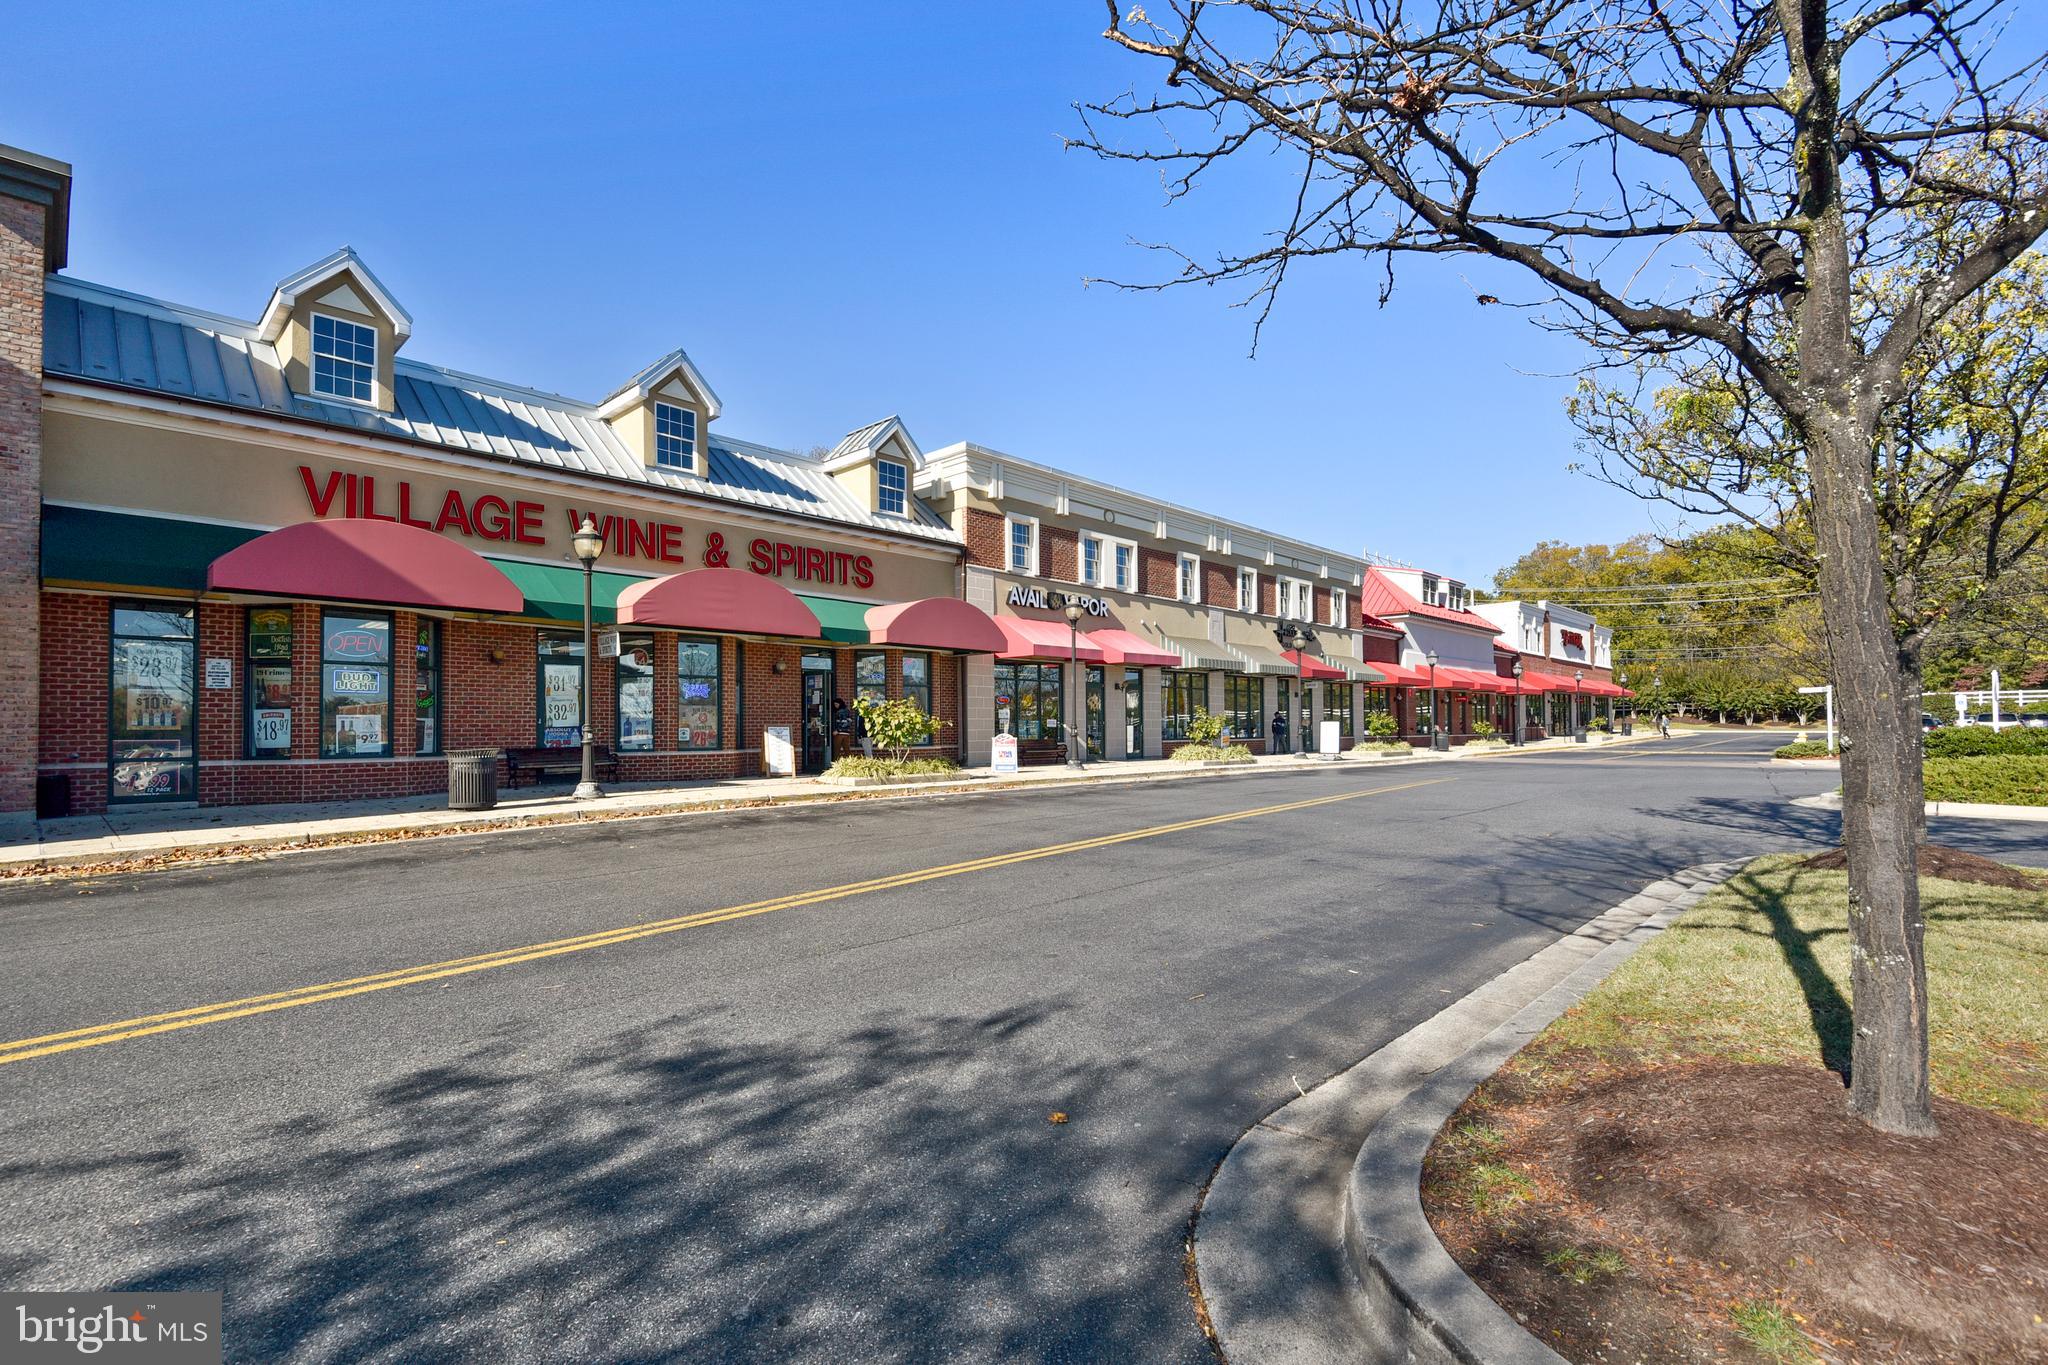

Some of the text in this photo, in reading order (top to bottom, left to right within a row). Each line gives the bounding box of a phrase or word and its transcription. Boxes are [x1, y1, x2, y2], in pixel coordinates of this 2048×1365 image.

[298, 465, 874, 589] VILLAGE WINE & SPIRITS
[1008, 585, 1109, 617] AVAIL VPOR
[328, 634, 384, 652] OPEN
[336, 680, 377, 691] LIGHT
[342, 672, 371, 682] BUD
[257, 719, 289, 741] $18.97
